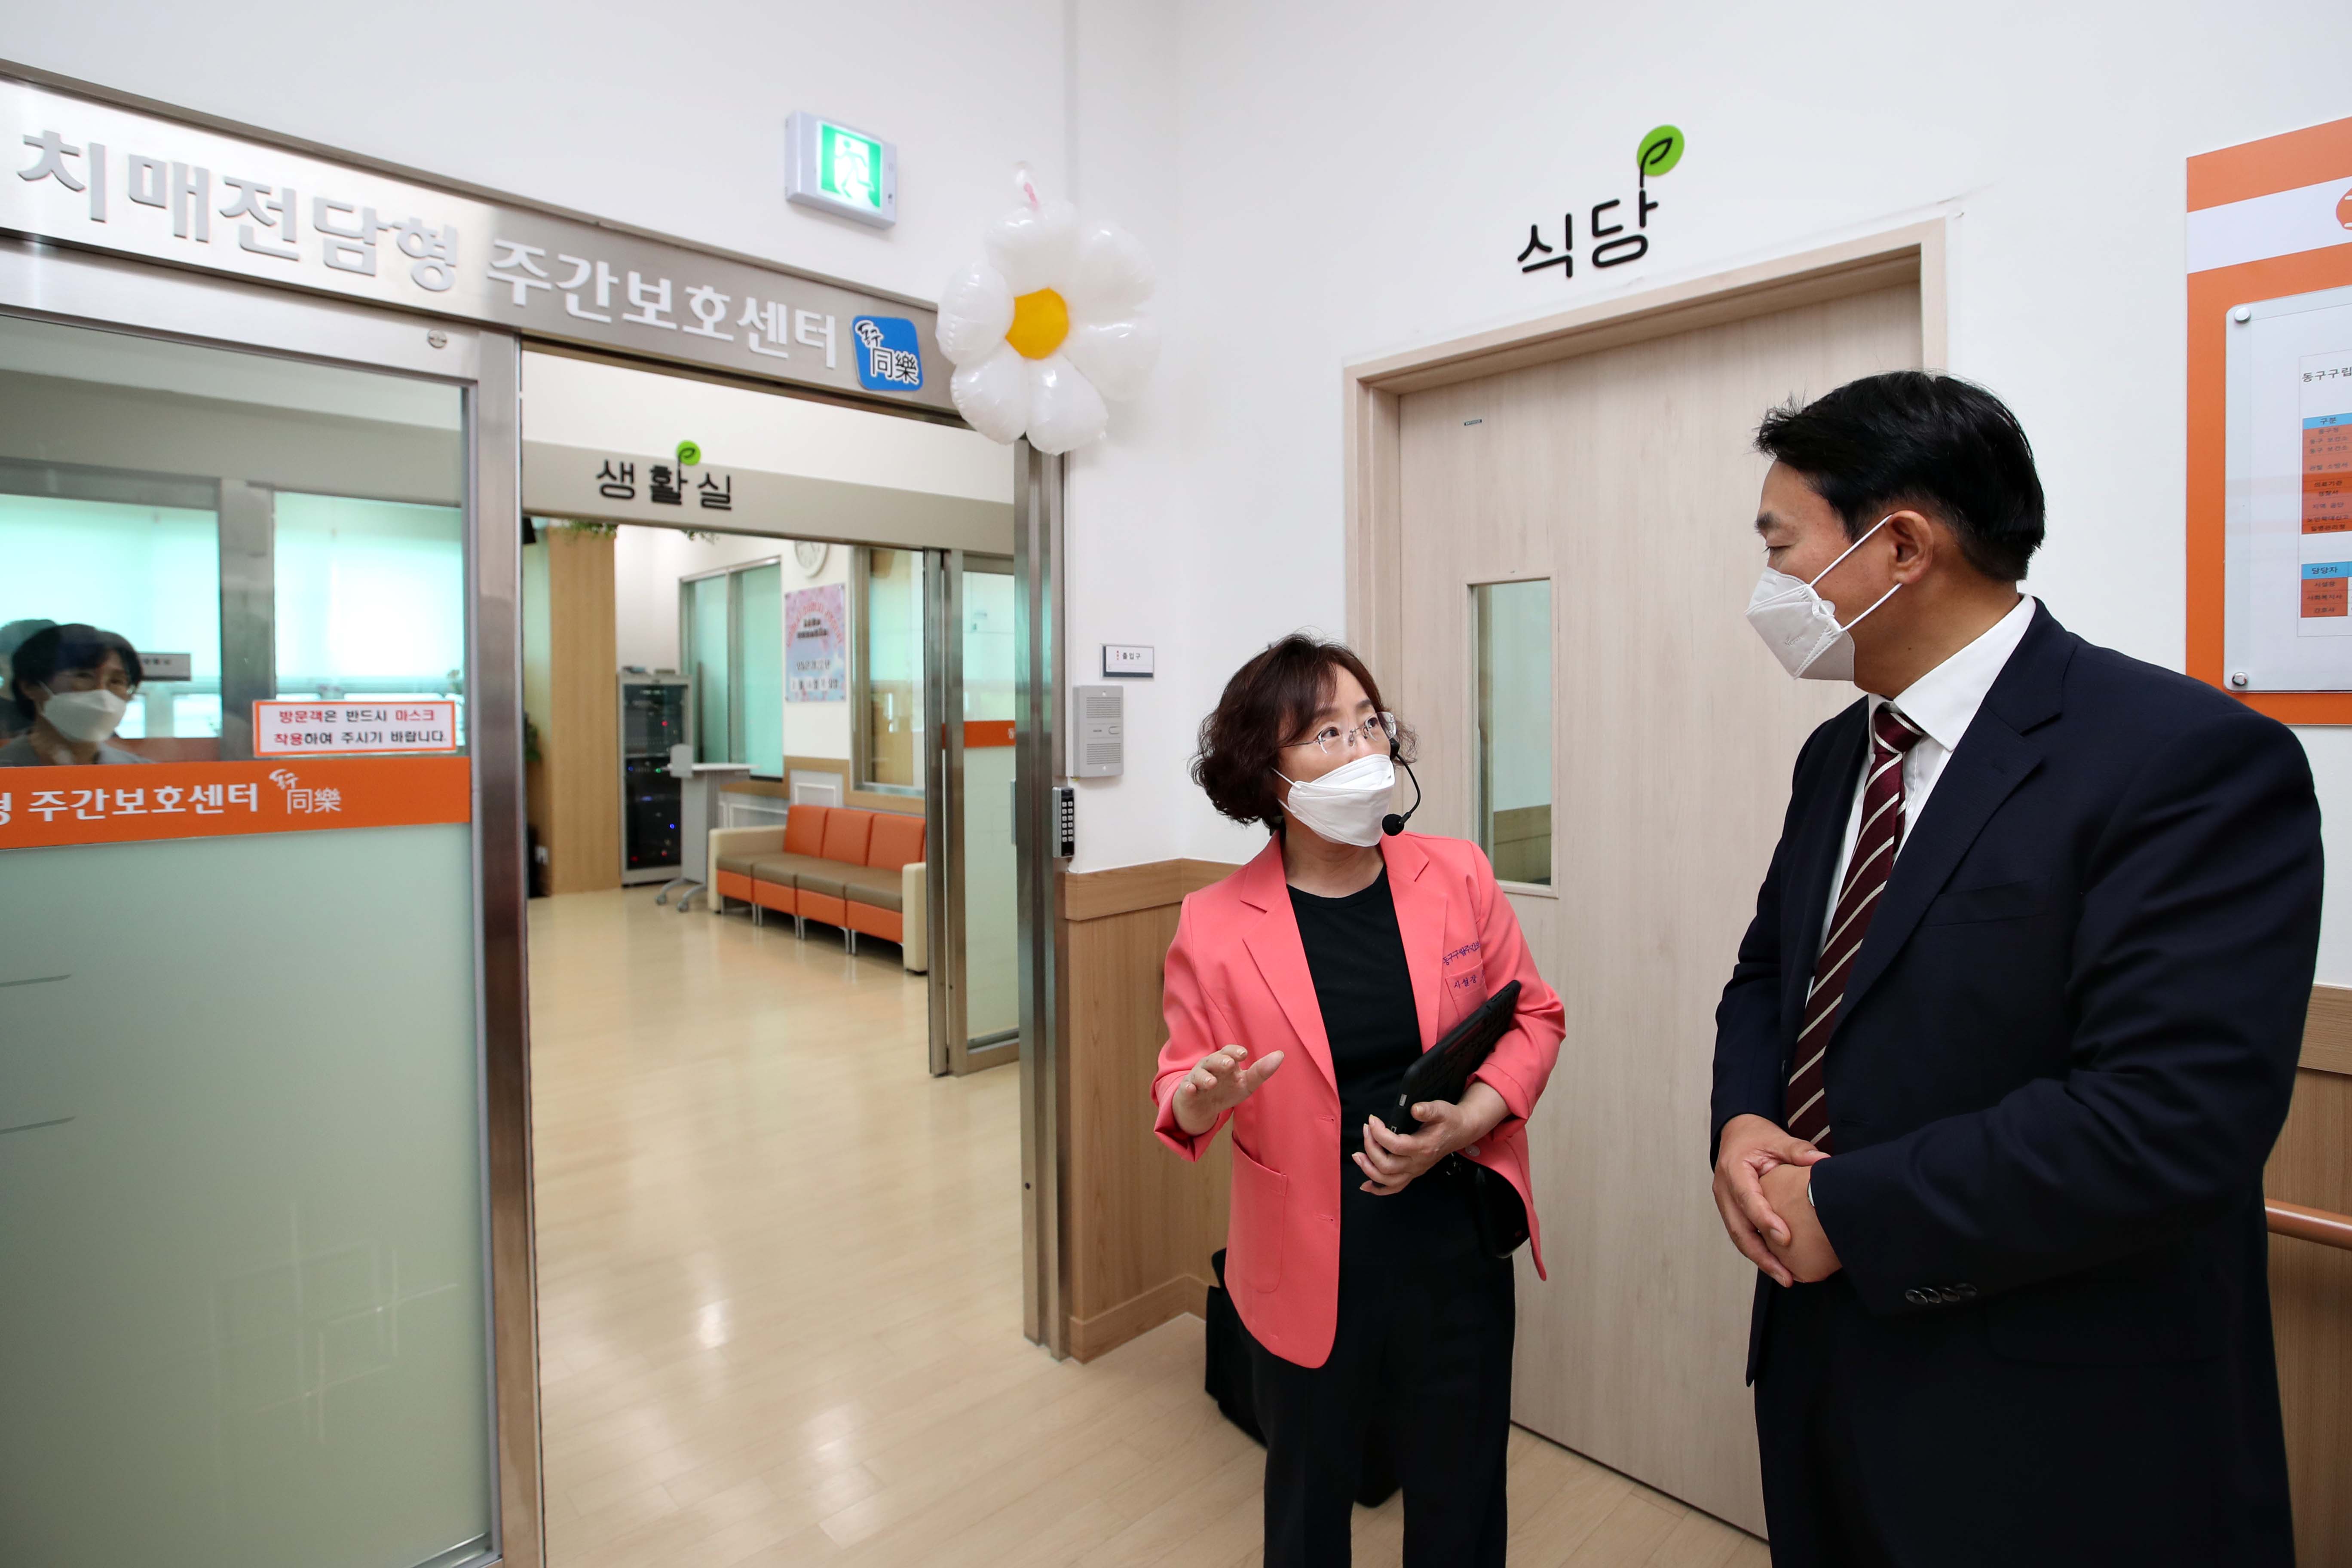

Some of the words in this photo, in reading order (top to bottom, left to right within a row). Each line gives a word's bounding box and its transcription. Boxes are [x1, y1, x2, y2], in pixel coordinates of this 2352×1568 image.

[1517, 189, 1659, 279] 식당
[17, 130, 457, 292] 치매전담형
[486, 238, 836, 370] 주간보호센터
[872, 348, 918, 383] 同樂
[2302, 366, 2352, 383] 동구구립
[596, 459, 732, 511] 생활실
[2311, 566, 2338, 575] 담당자
[279, 710, 337, 723] 방문객은
[346, 709, 387, 723] 반드시
[395, 709, 435, 722] 마스크
[274, 732, 333, 745] 착용하여
[341, 731, 383, 744] 주시기
[390, 730, 447, 743] 바랍니다.
[28, 783, 258, 822] 주간보호센터
[287, 787, 342, 815] 同樂
